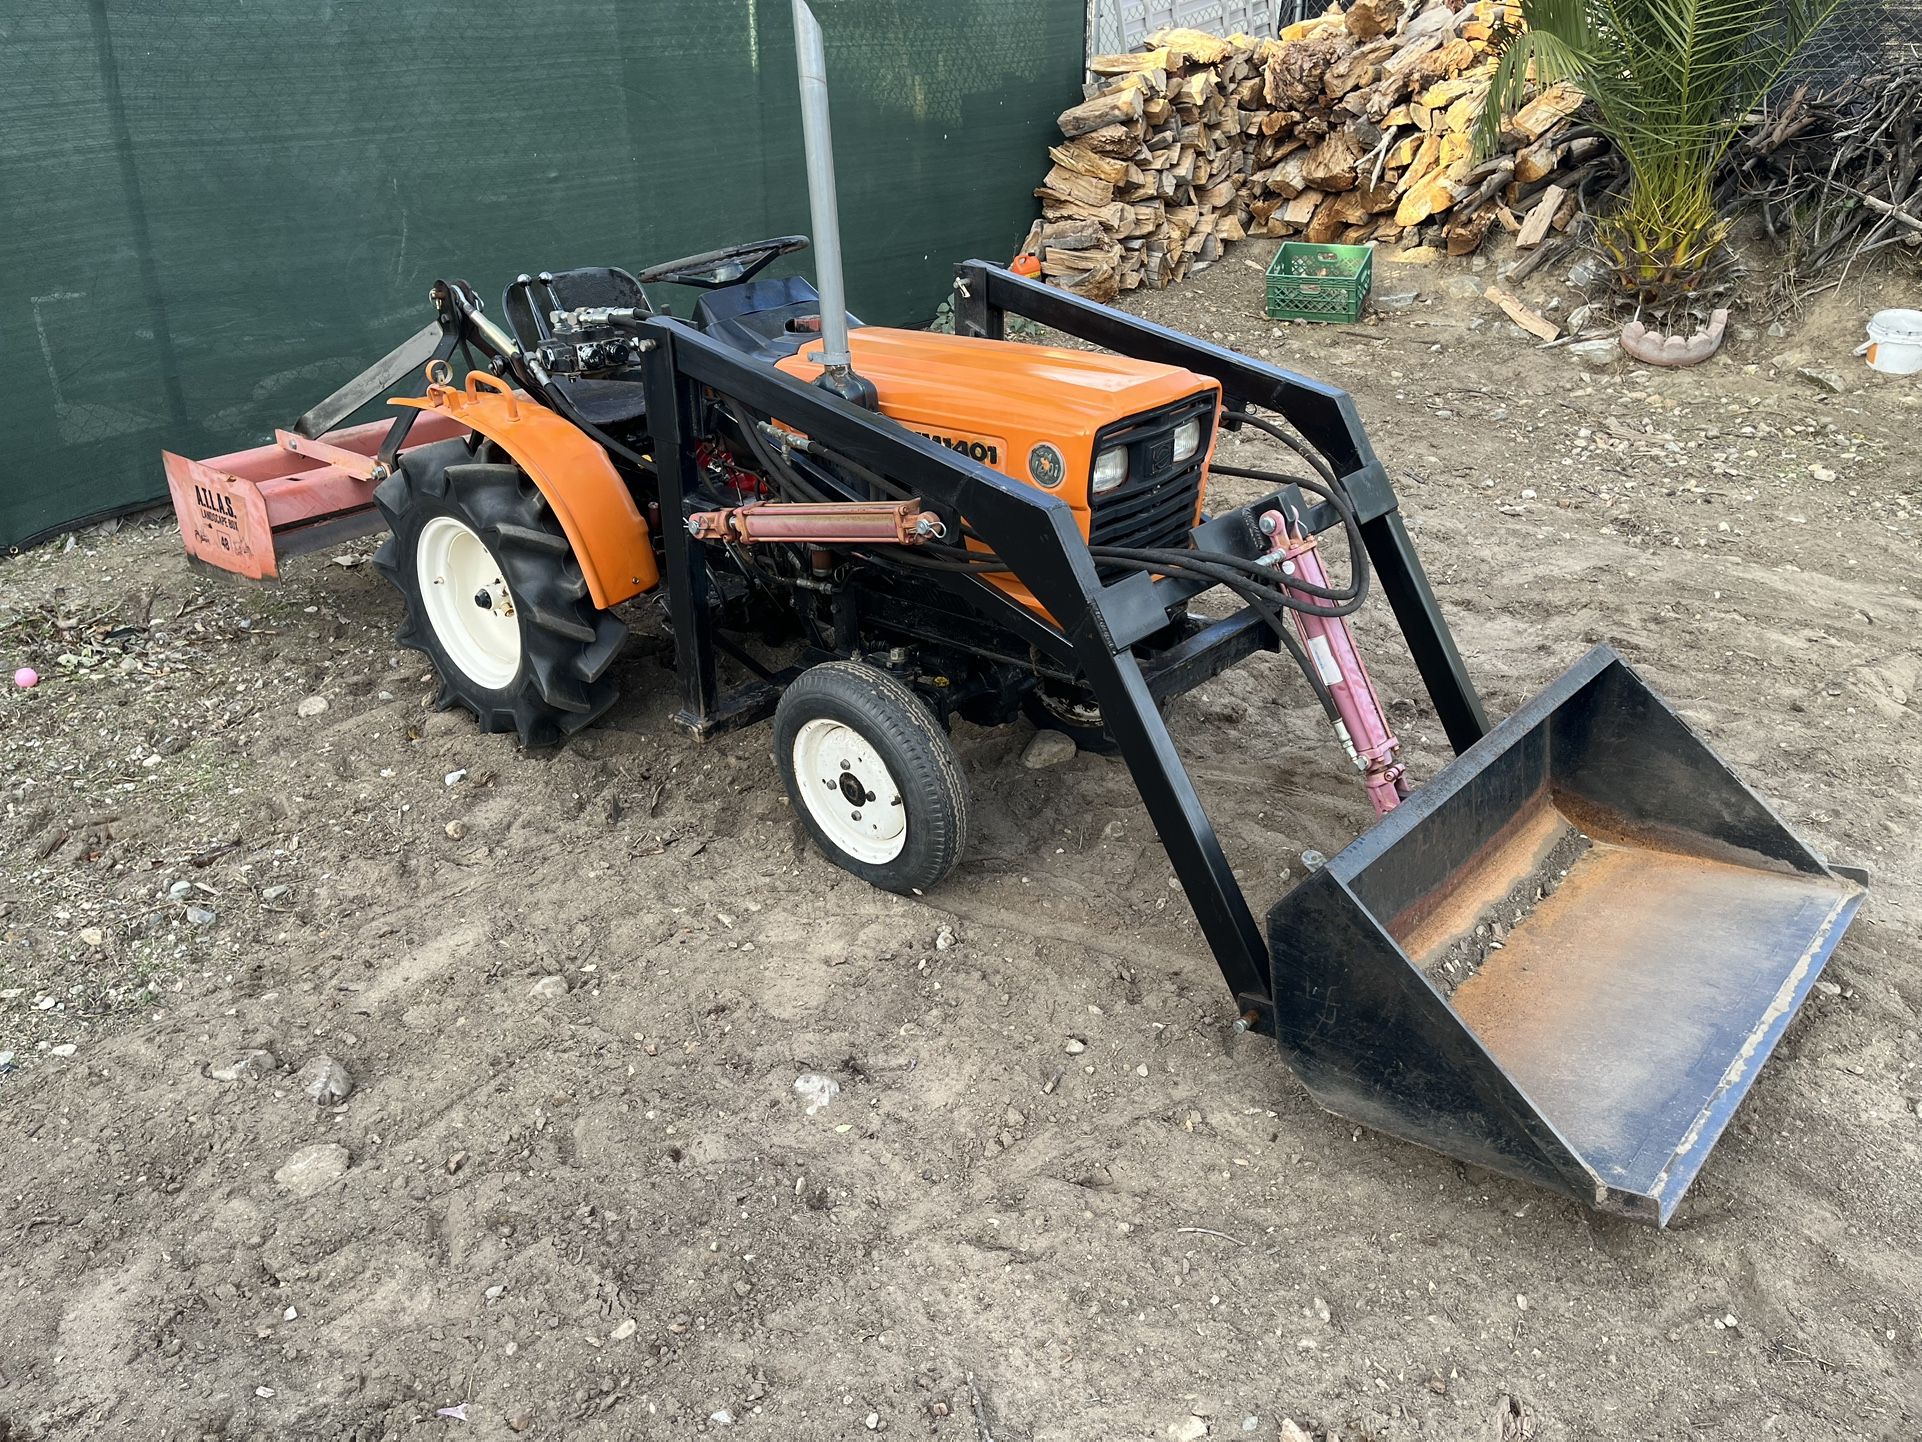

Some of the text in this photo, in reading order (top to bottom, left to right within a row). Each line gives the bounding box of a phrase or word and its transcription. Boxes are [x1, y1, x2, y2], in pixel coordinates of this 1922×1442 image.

[200, 508, 239, 532] LANDSCAPE BOX
[220, 536, 230, 551] 48
